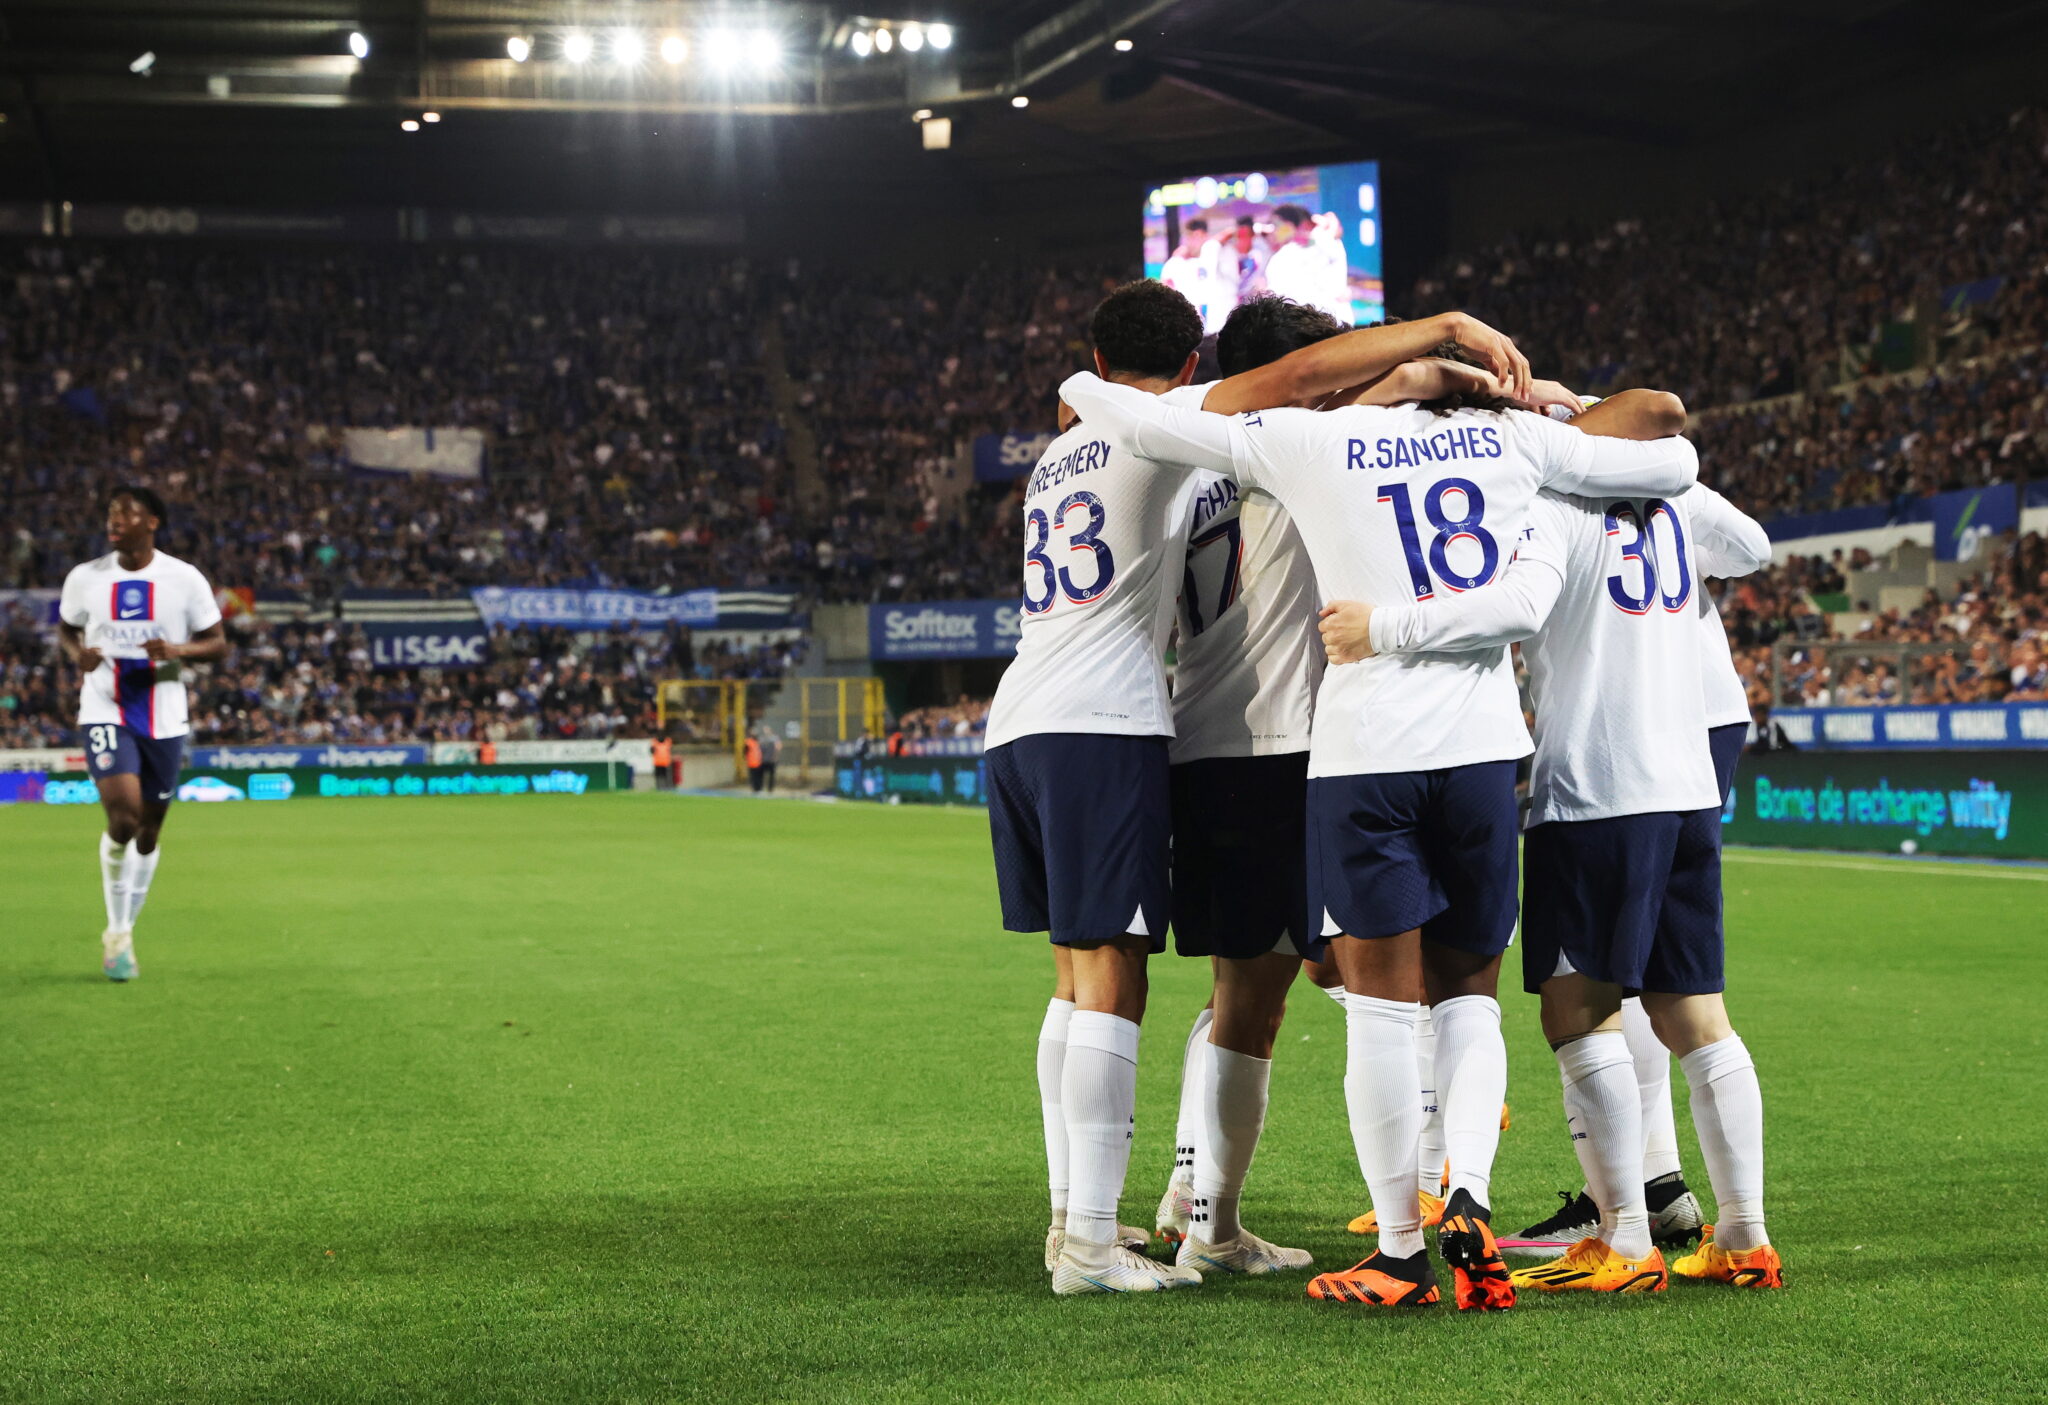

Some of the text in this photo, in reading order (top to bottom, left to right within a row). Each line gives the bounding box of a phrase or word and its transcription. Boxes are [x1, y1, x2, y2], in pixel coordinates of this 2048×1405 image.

[1347, 427, 1502, 470] R.SANCHES
[1023, 491, 1116, 616] 33
[1377, 477, 1499, 602] 18
[1605, 499, 1692, 616] 30
[374, 635, 487, 665] LISSAC
[89, 725, 118, 753] 31
[319, 773, 391, 797] Borne
[393, 773, 425, 797] de
[428, 772, 529, 795] recharge
[1755, 775, 1816, 821] Borne
[1817, 778, 1845, 822] de
[1848, 778, 1947, 836] recharge
